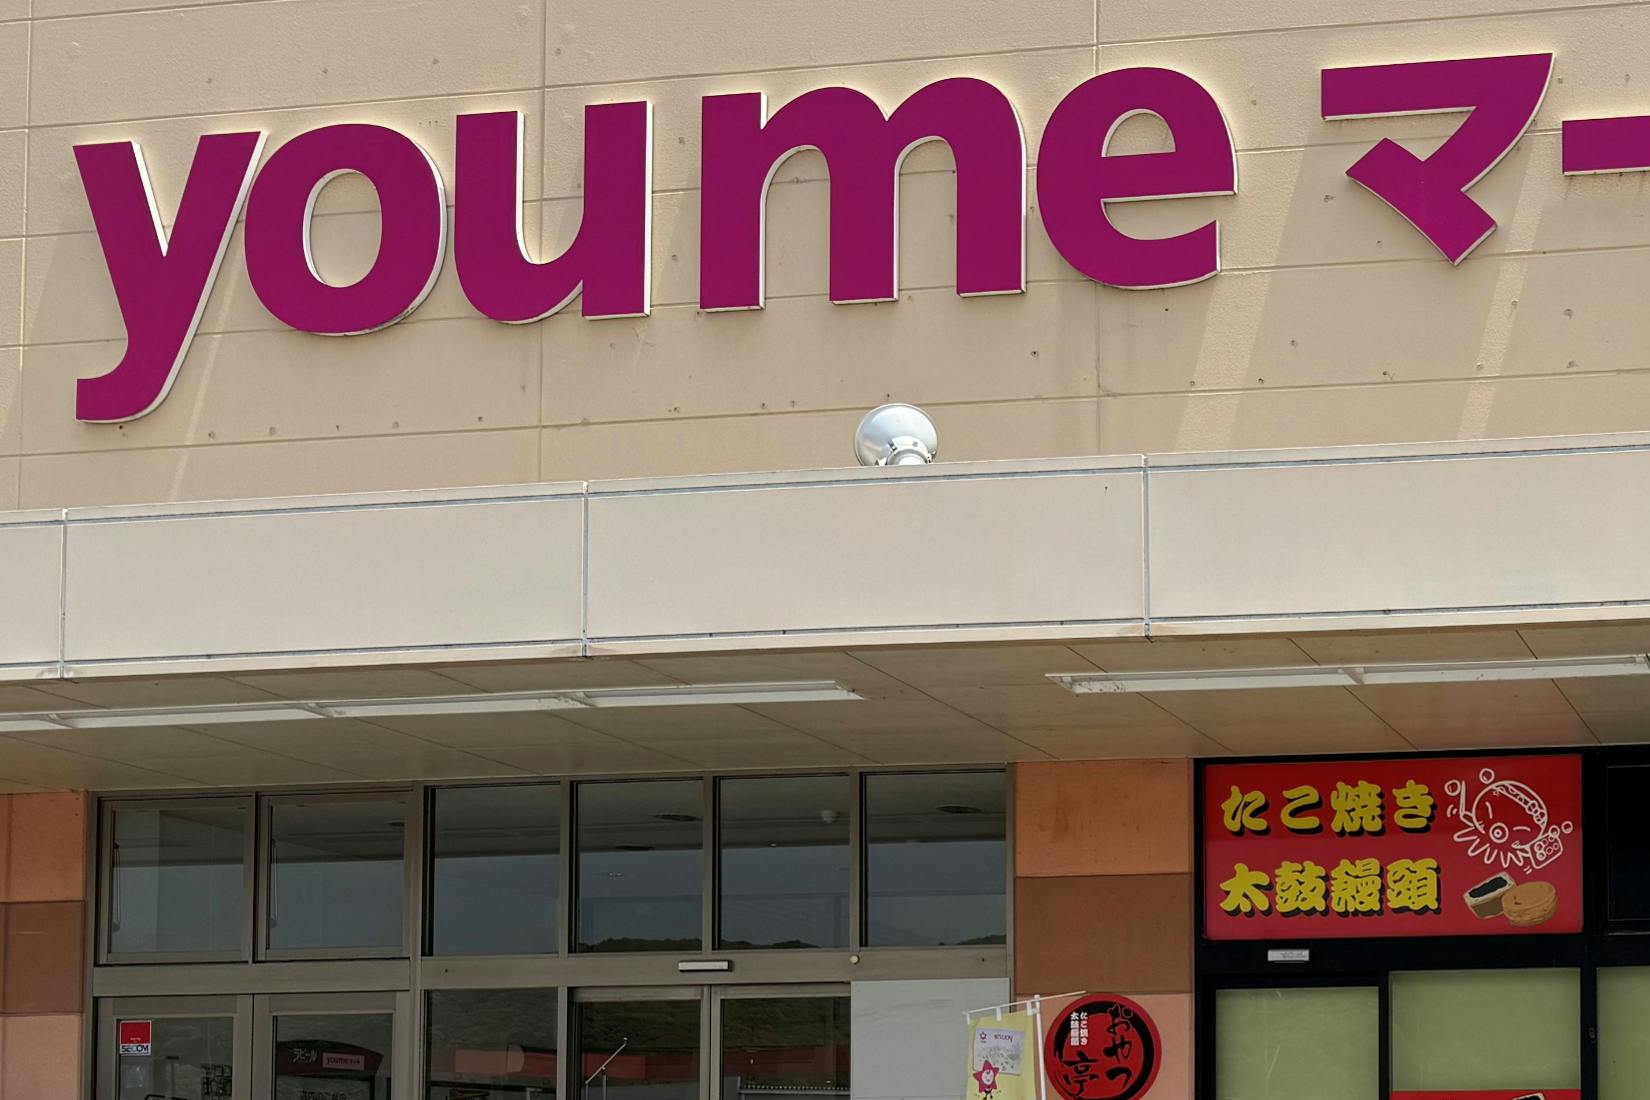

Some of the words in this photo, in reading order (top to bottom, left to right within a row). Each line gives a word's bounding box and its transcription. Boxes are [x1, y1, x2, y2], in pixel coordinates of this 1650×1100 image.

[75, 66, 1238, 423] youme
[1221, 779, 1435, 834] たこ焼き
[1219, 857, 1441, 913] 太鼓饅頭
[1060, 1050, 1099, 1098] 亭
